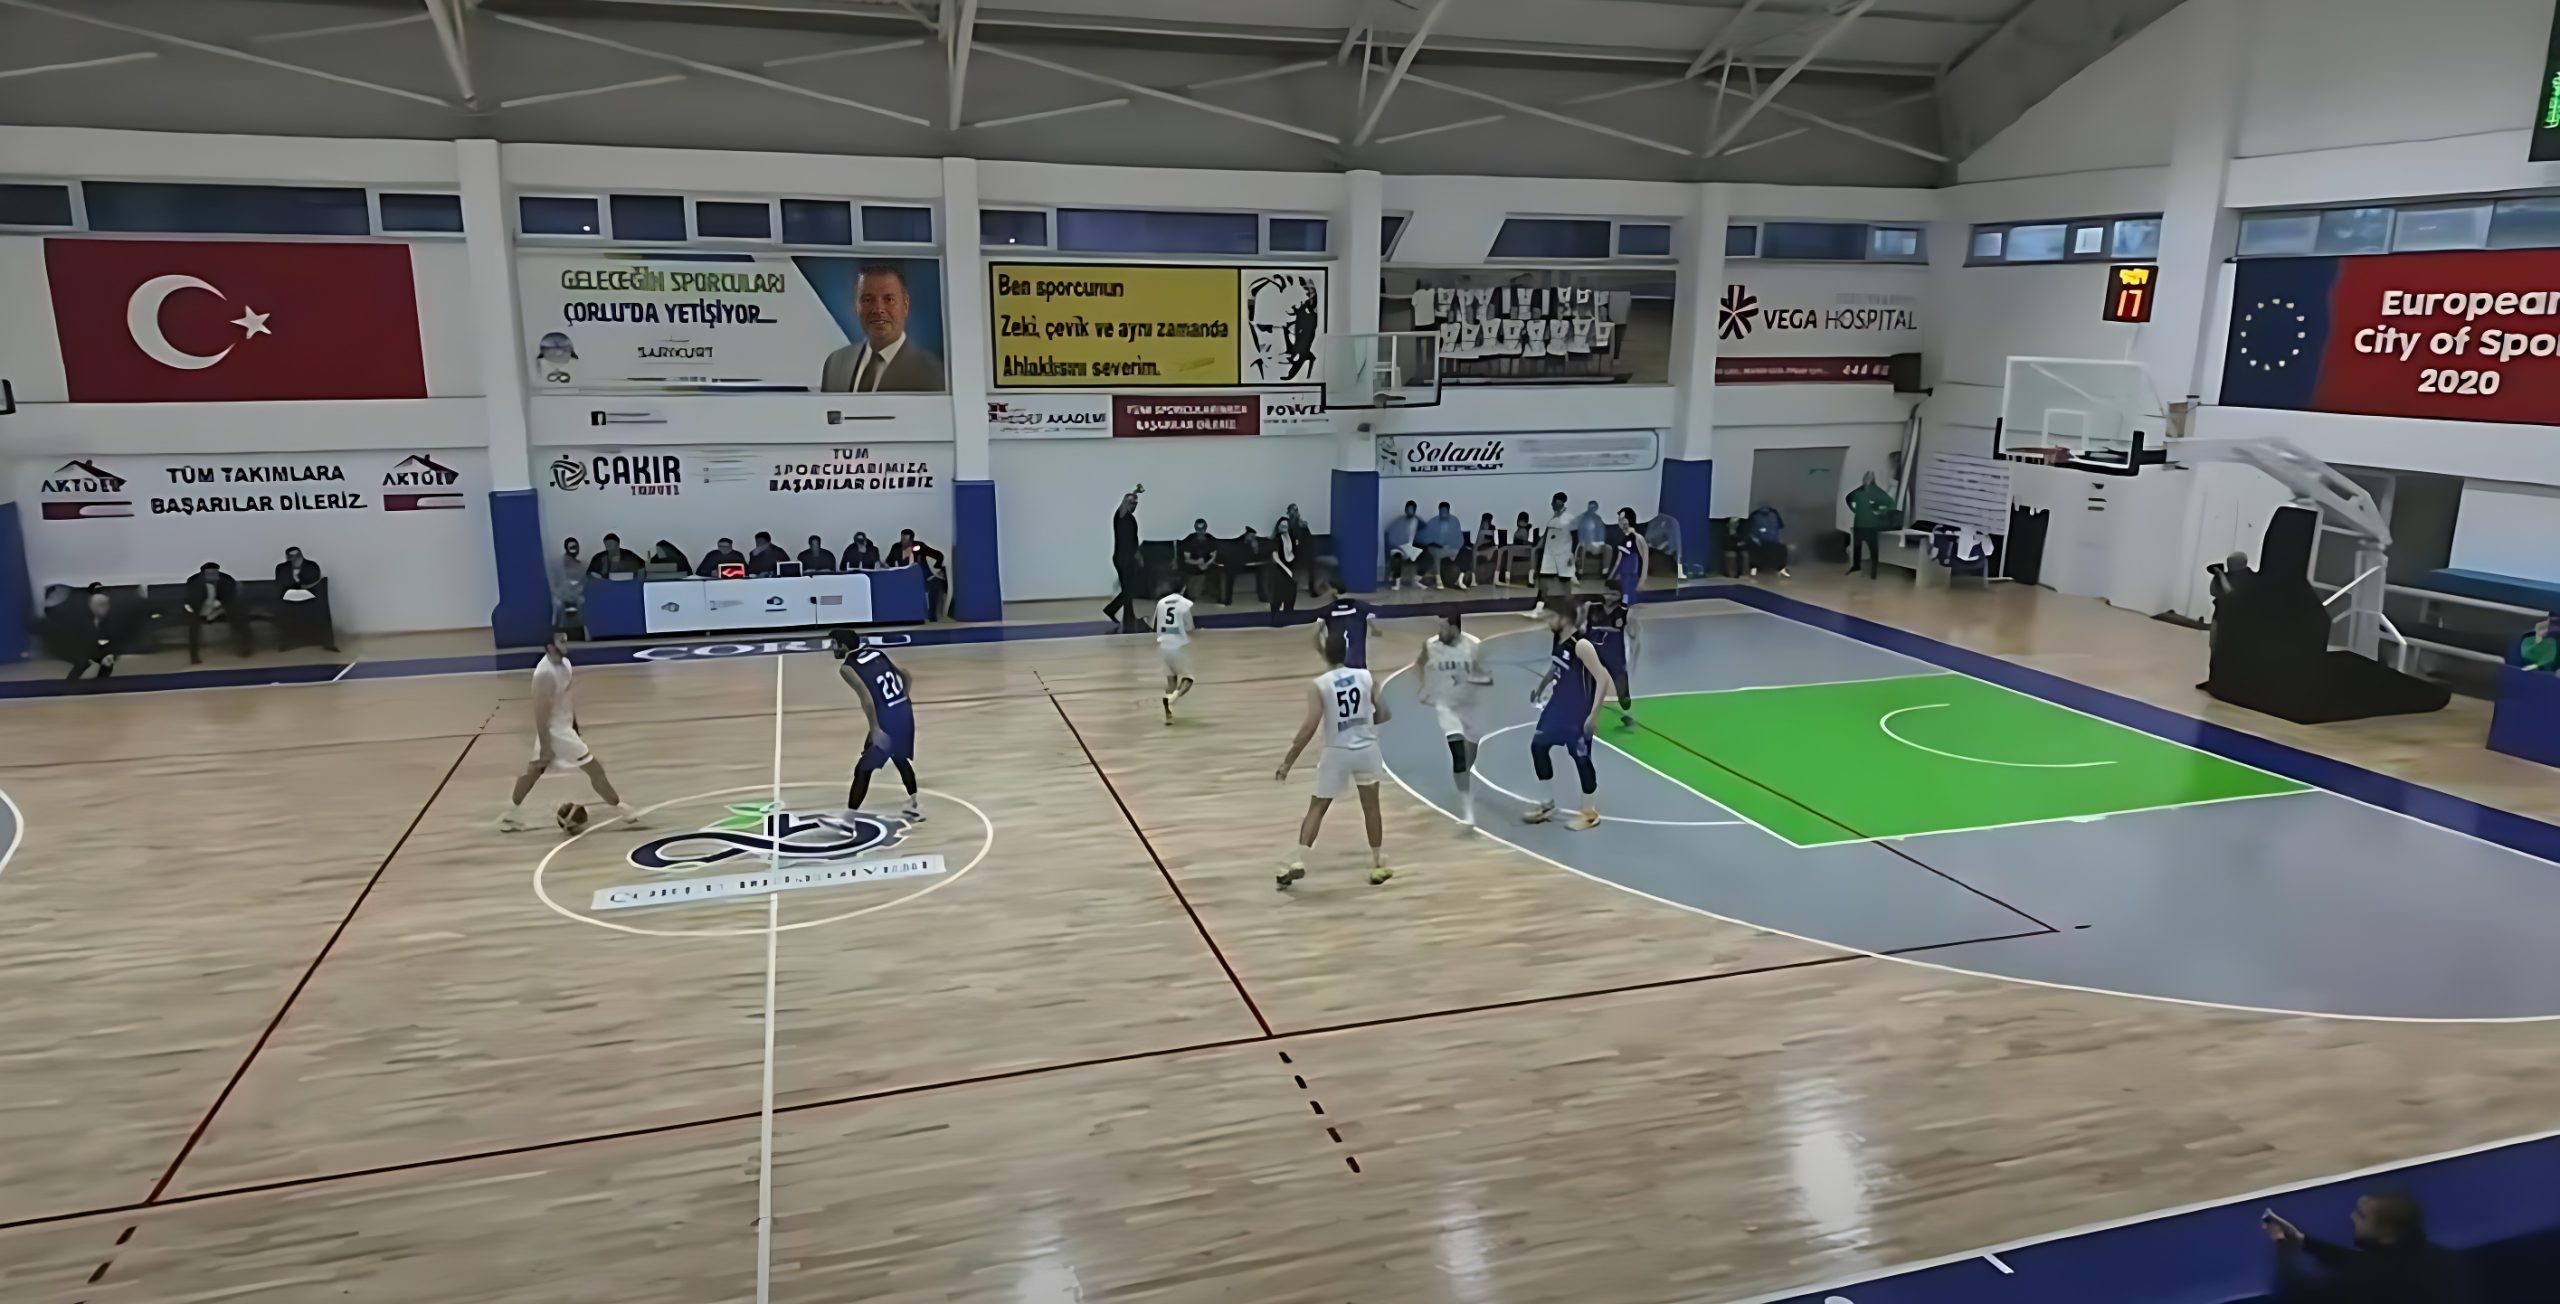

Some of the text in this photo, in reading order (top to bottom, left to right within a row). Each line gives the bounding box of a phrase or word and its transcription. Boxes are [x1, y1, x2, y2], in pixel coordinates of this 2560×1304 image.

[671, 271, 785, 293] SPORCULARI
[998, 274, 1125, 302] Ben sporcunun
[1000, 314, 1040, 338] Zeki,
[1045, 315, 1089, 340] çevik
[1095, 321, 1114, 338] ve
[1157, 319, 1229, 338] zamanda
[1763, 308, 1918, 331] VEGA HOSPITAL
[2354, 324, 2560, 362] City of Spo
[2417, 368, 2501, 395] 2020
[166, 464, 345, 484] TÜM TAKIMLARA
[592, 455, 682, 490] ÇAKIR
[150, 494, 274, 516] BAŞARILAR
[1165, 607, 1176, 625] 5
[1336, 686, 1361, 718] 59
